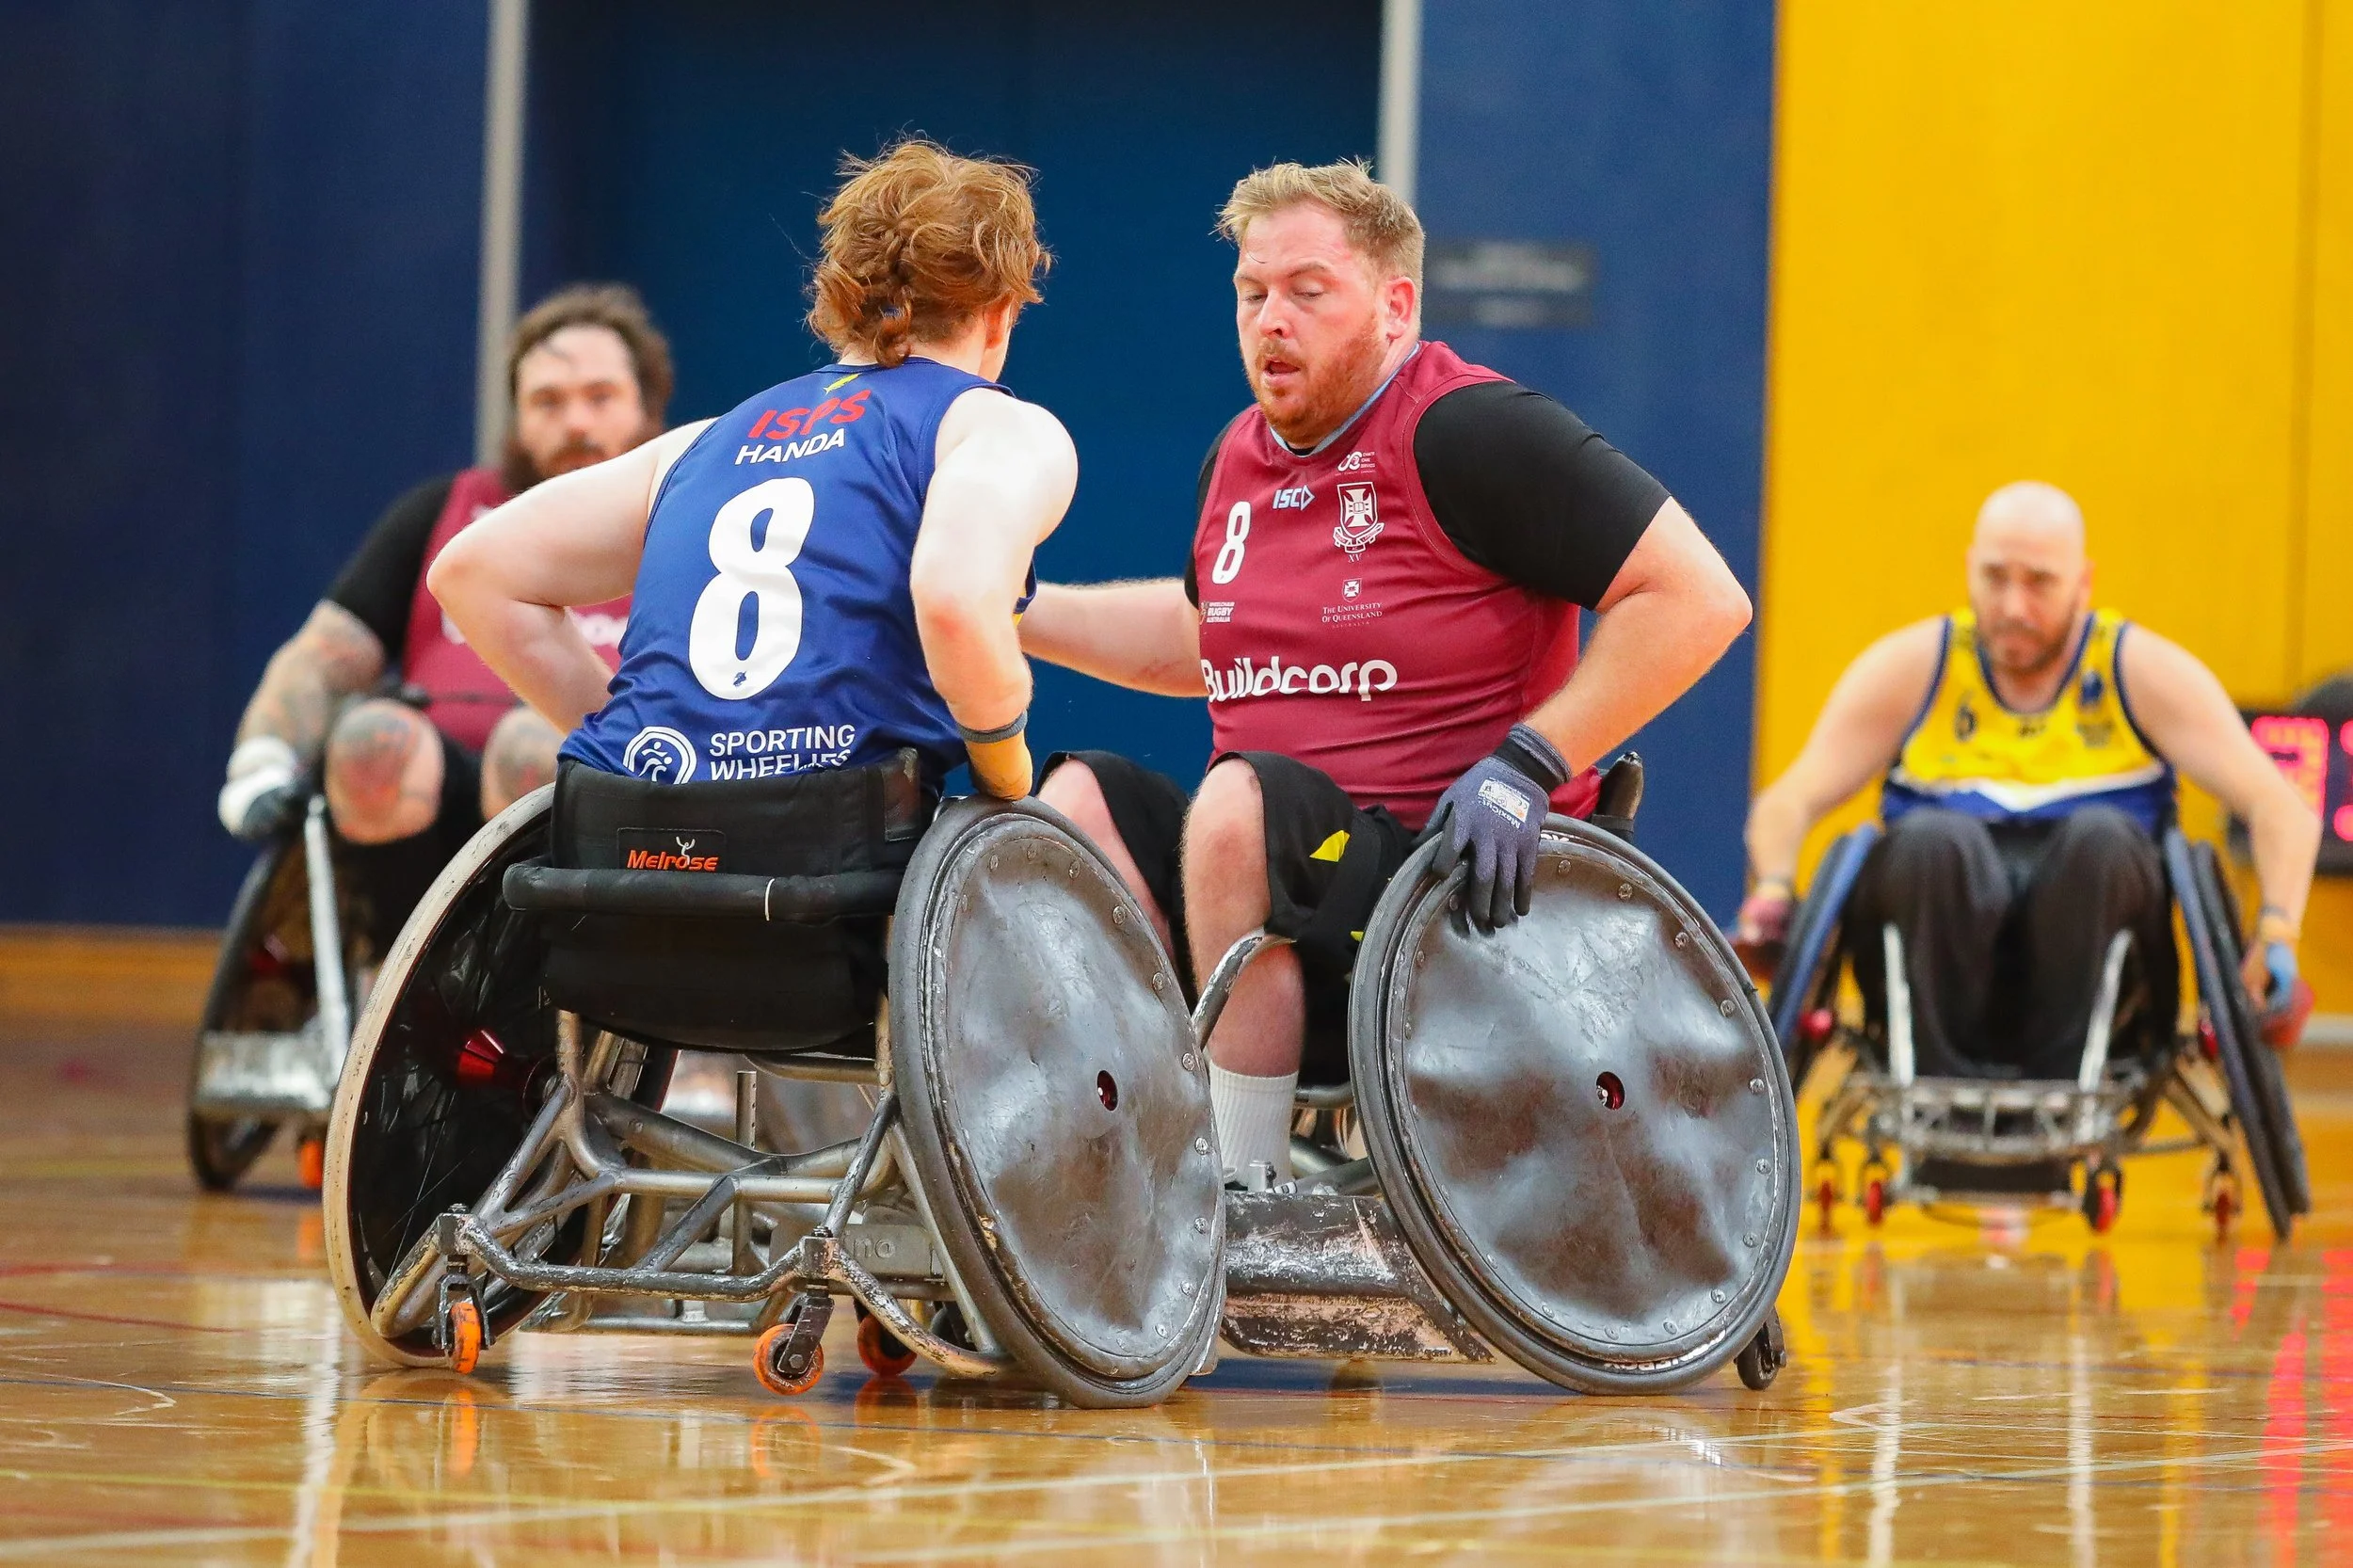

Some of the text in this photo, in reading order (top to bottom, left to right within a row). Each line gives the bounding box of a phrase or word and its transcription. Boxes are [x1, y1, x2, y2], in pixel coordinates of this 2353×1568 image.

[748, 390, 872, 440] ISPS
[735, 428, 845, 465] HANDA
[1273, 488, 1303, 510] ISC
[1211, 501, 1252, 584] 8
[688, 477, 815, 700] 8
[1208, 607, 1234, 616] RUGBY
[1321, 611, 1383, 624] OF QUEENSLAND
[1322, 602, 1382, 615] THE UNIVERSITY
[1200, 656, 1399, 703] Buildcorp
[710, 724, 856, 757] SPORTING
[627, 849, 719, 872] Melrose
